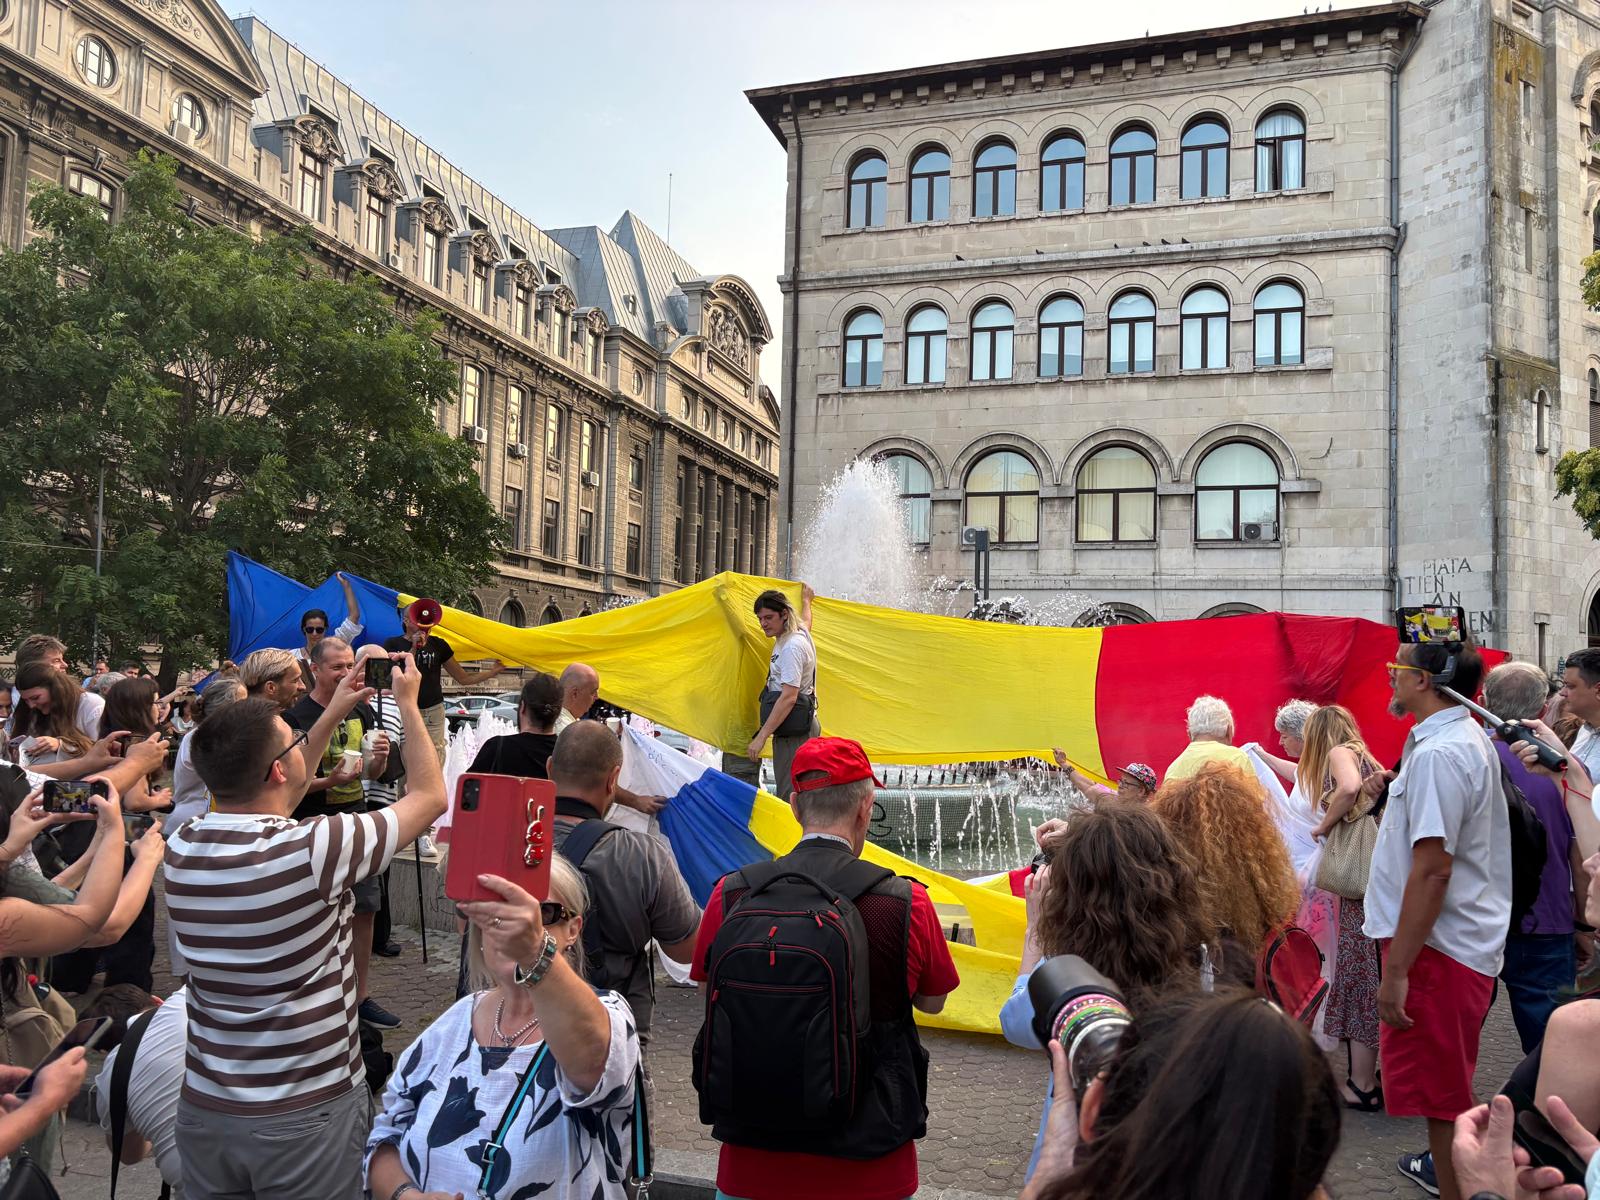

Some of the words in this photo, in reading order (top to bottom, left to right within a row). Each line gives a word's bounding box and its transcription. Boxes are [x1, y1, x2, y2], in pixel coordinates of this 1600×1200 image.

[1404, 575, 1445, 594] TIEN
[1431, 591, 1461, 606] AN
[1469, 610, 1493, 634] EN
